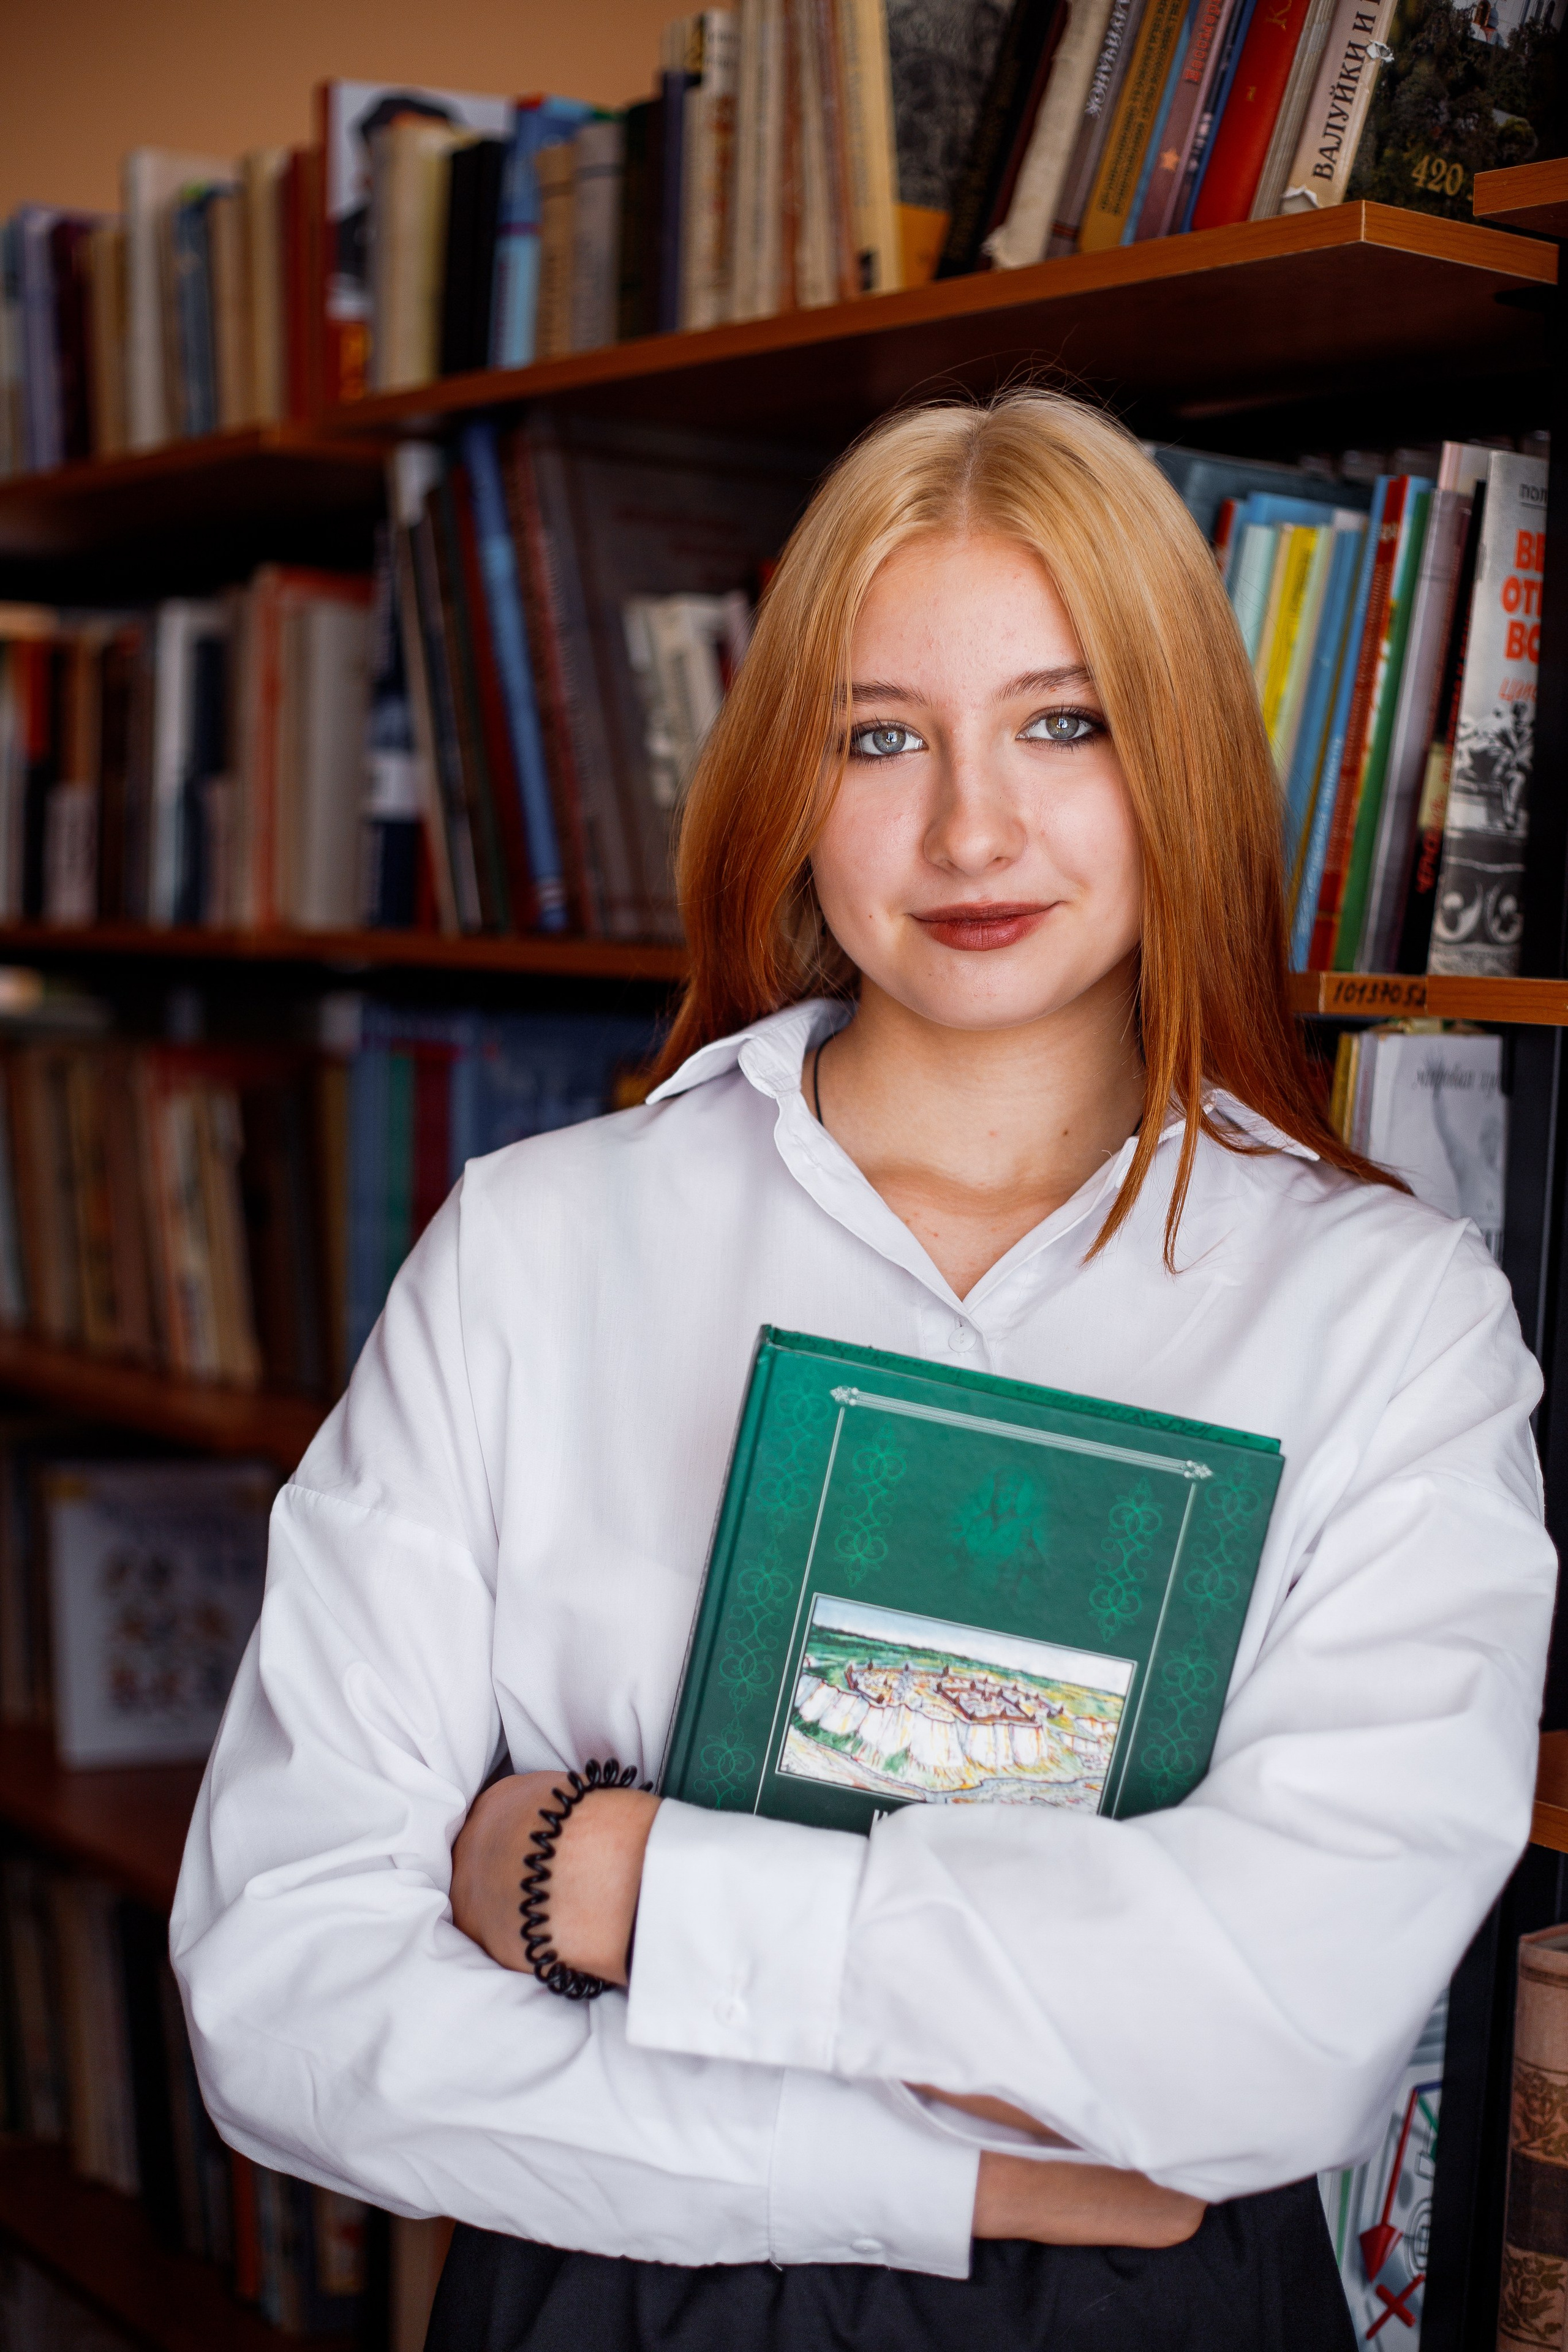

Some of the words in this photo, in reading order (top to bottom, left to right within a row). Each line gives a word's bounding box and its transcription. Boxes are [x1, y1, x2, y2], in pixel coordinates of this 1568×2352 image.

[1313, 40, 1367, 181] ВАЛУЙКИ
[1352, 11, 1376, 34] И
[1411, 154, 1464, 196] 420
